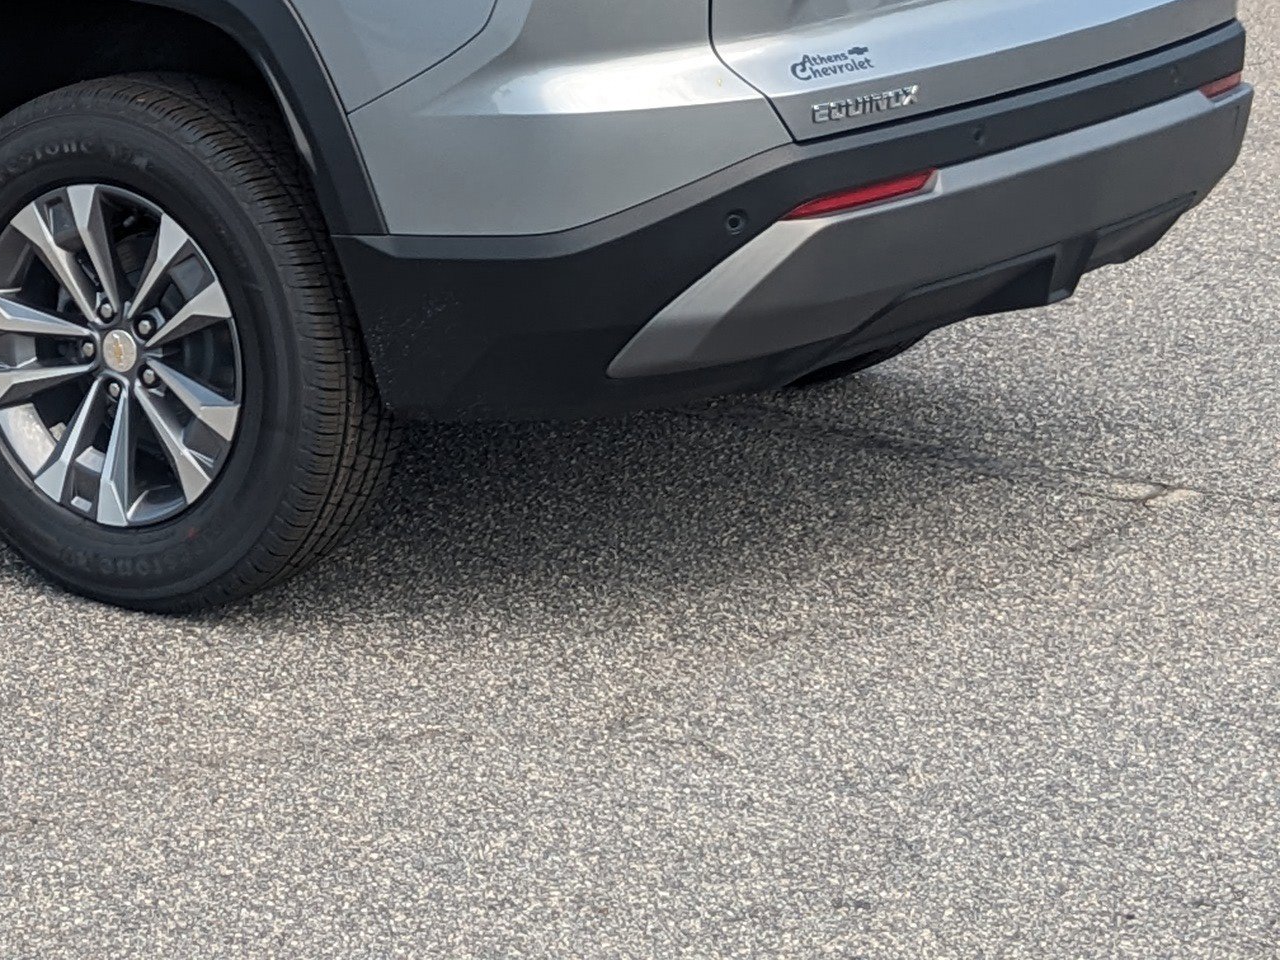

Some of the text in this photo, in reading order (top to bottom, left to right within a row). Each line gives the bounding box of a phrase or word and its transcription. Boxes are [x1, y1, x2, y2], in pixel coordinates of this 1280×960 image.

[790, 56, 875, 81] Chevrolet
[800, 52, 849, 67] Athens
[811, 84, 920, 124] EQUINOX
